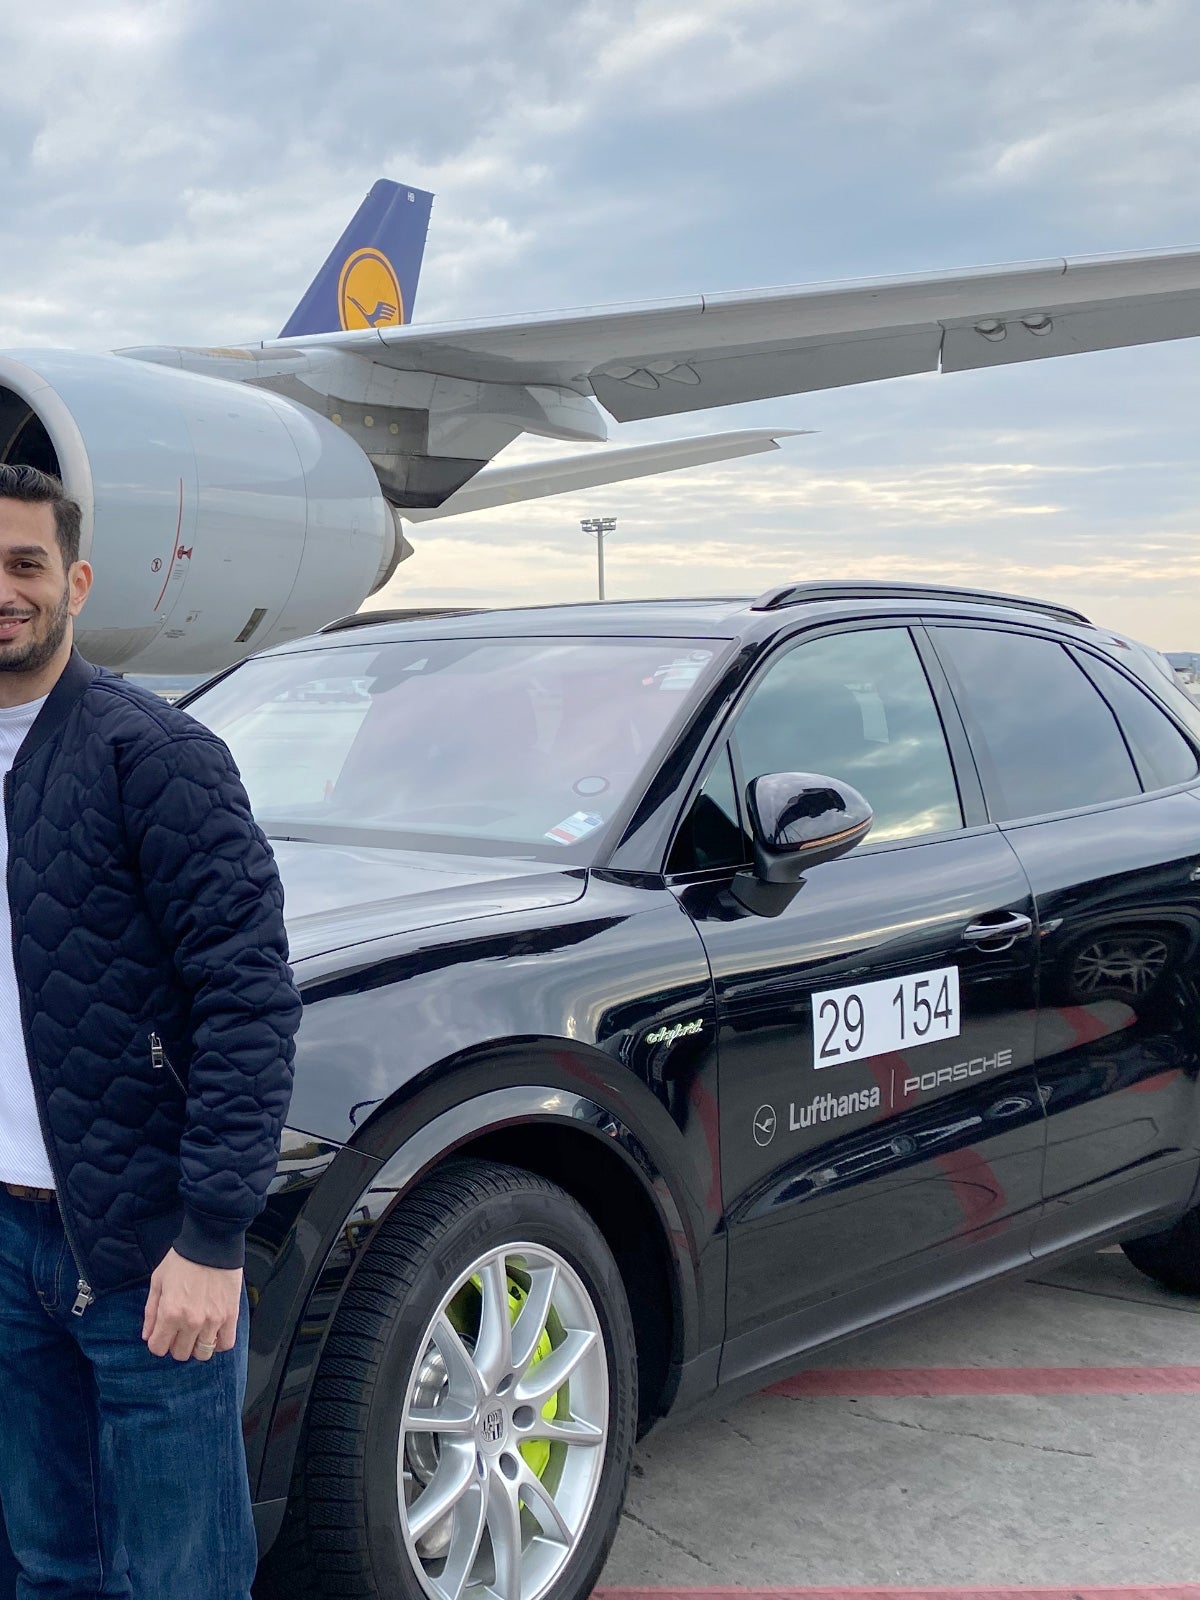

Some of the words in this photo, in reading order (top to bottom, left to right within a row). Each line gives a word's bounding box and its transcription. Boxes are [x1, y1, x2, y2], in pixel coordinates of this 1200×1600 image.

[819, 993, 865, 1059] 29
[892, 974, 953, 1040] 154
[789, 1085, 880, 1131] Lufthansa
[904, 1049, 1013, 1097] PORSCHE
